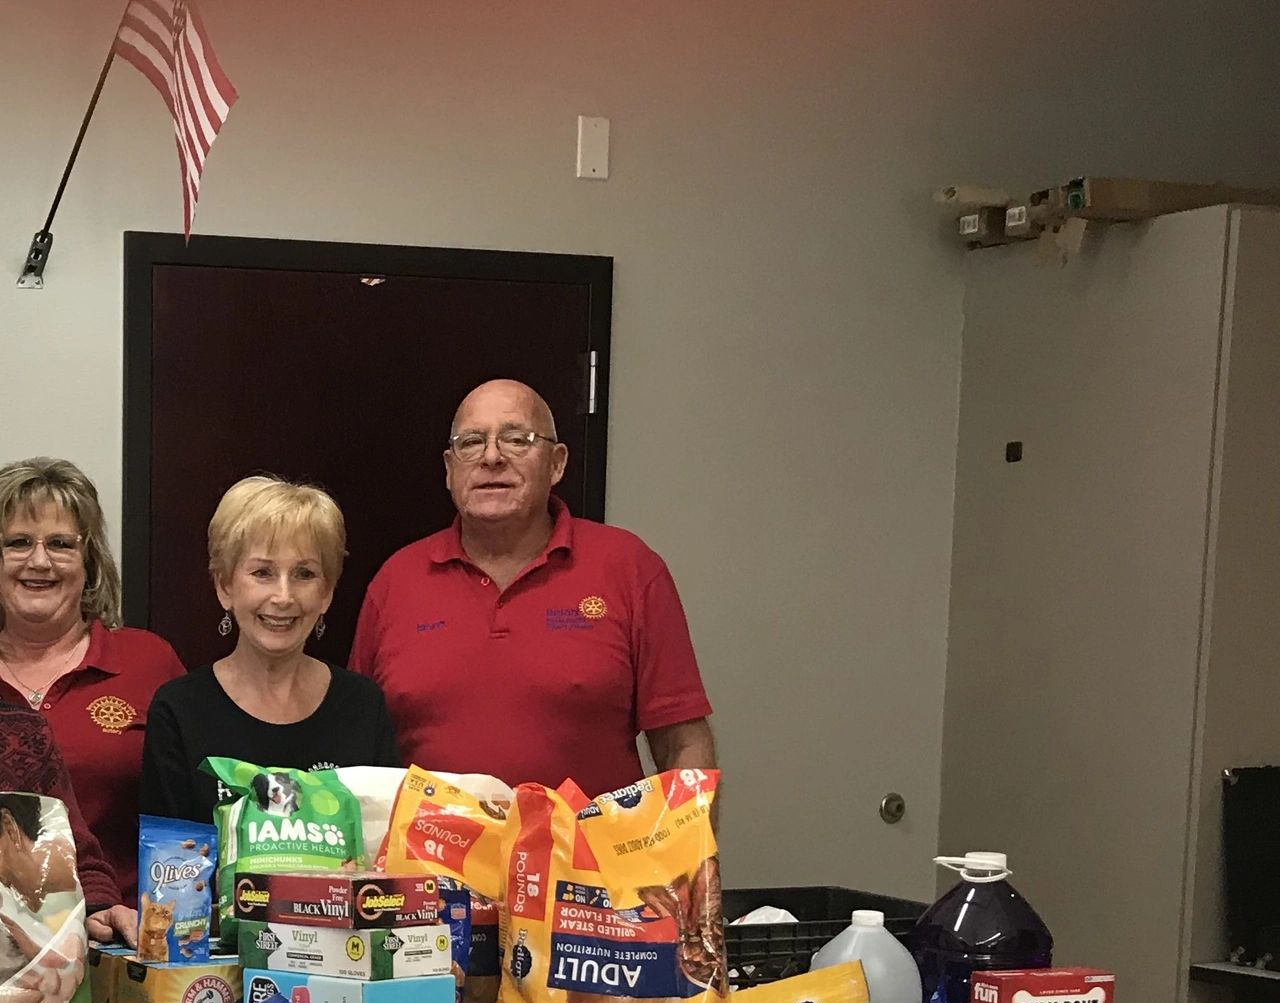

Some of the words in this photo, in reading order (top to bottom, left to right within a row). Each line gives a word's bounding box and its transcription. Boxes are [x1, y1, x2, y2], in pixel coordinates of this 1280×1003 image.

[248, 818, 323, 844] IAMS
[414, 820, 470, 848] POUNDS
[249, 841, 308, 853] PROACTIVE
[311, 845, 346, 855] HEALTH
[424, 839, 445, 860] 18
[150, 862, 202, 894] 9Lives
[513, 851, 528, 913] POUNDS
[526, 871, 540, 898] 18
[362, 895, 405, 909] JobSelect
[293, 903, 320, 915] BLACK
[320, 899, 349, 920] Vinyl
[417, 910, 438, 921] Vinyl
[560, 906, 603, 921] FLAVOR
[175, 919, 207, 930] CRUNCHY
[559, 918, 594, 931] STEAK
[597, 924, 636, 938] GRILLED
[258, 930, 278, 941] FIRST
[292, 930, 318, 944] Vinyl
[407, 934, 428, 944] Vinyl
[351, 943, 360, 951] M
[556, 942, 611, 958] NUTRITION
[614, 950, 658, 960] COMPLETE
[554, 956, 642, 988] ADULT
[195, 982, 203, 991] &
[974, 983, 999, 1003] fun
